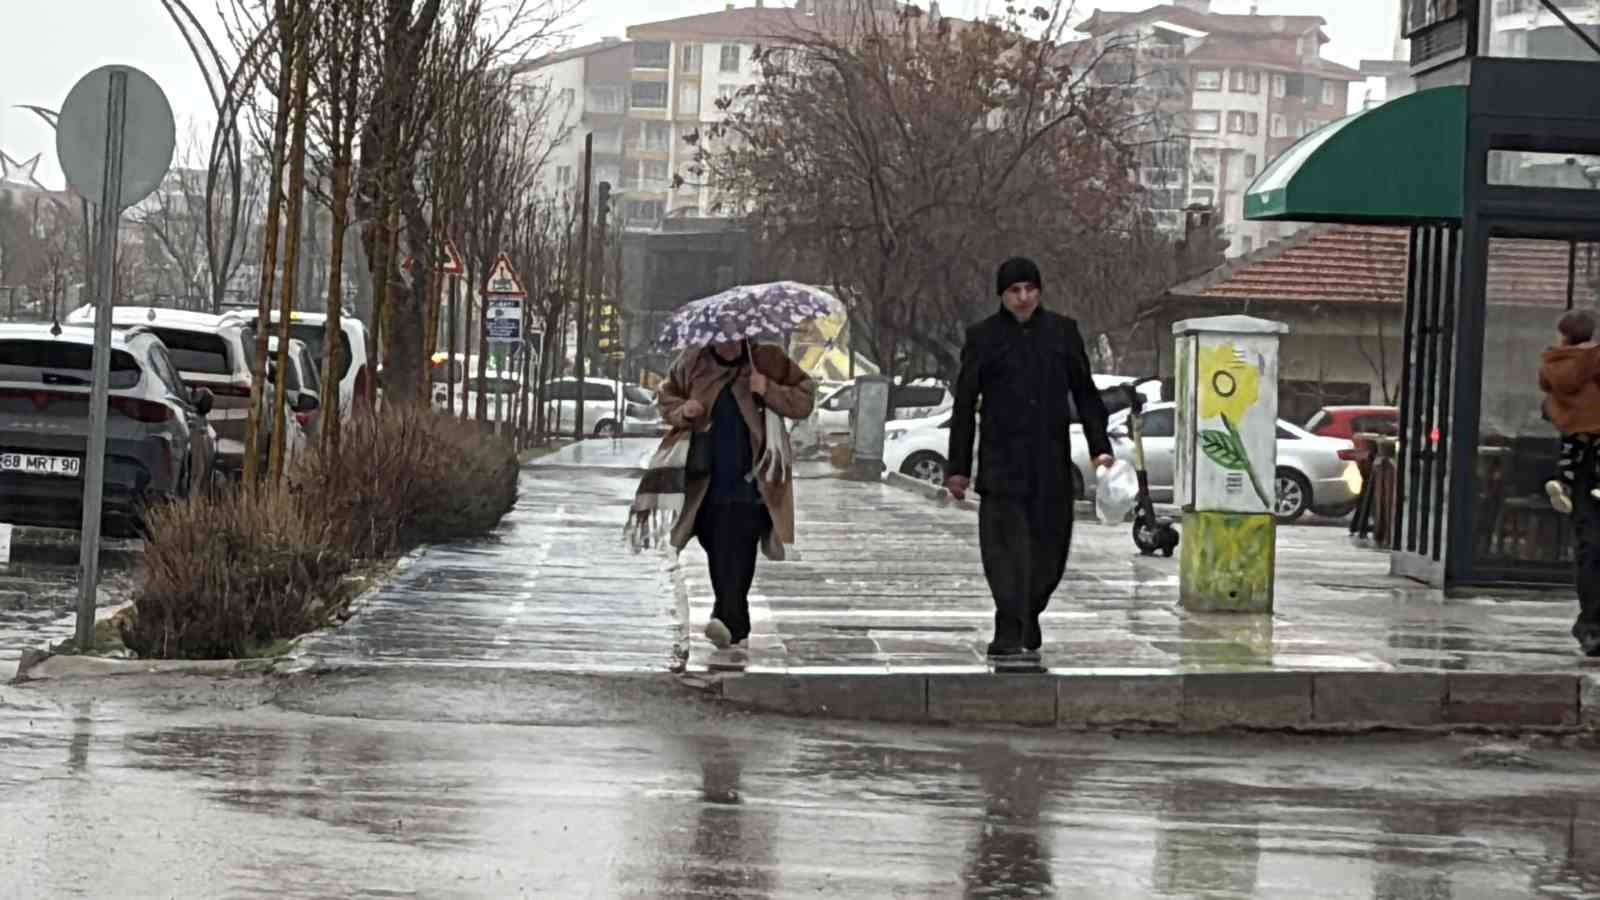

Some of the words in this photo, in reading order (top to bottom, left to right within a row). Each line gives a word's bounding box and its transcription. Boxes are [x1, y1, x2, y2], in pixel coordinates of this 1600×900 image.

[3, 455, 20, 468] 68
[26, 456, 56, 470] MRT
[62, 458, 78, 472] 90
